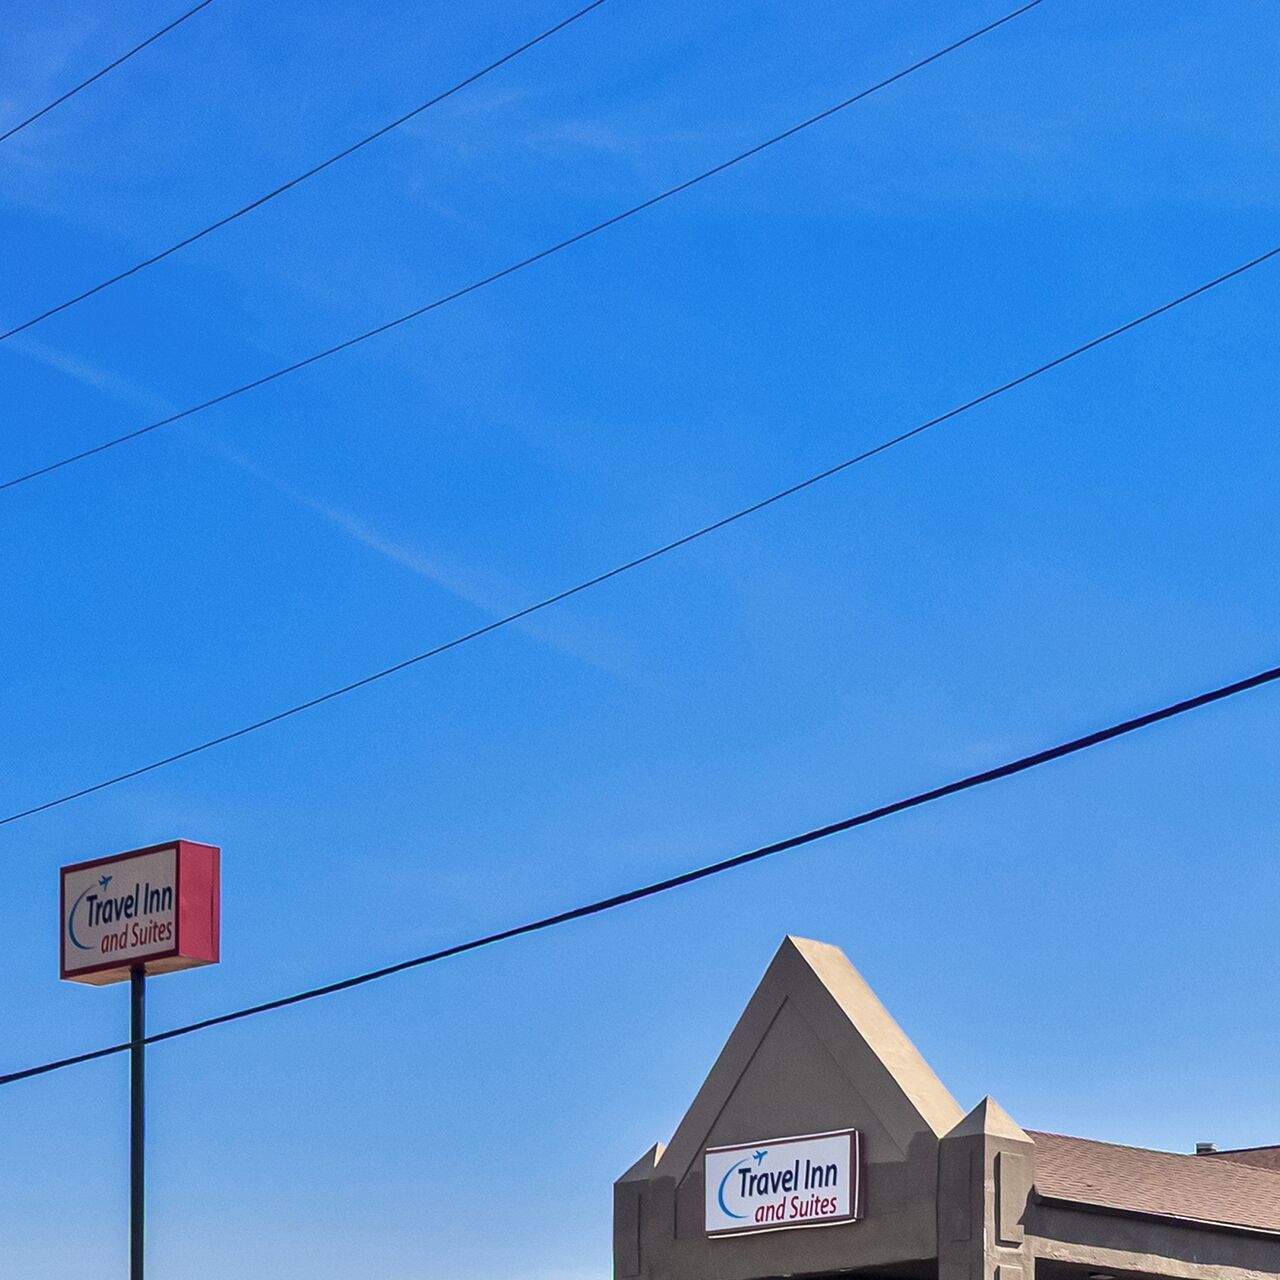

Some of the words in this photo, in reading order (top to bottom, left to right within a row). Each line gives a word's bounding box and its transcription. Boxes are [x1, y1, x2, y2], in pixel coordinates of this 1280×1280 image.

[86, 883, 138, 927] Travel
[143, 882, 173, 916] Inn
[101, 924, 128, 954] and
[130, 920, 173, 947] Suites
[738, 1160, 800, 1198] Travel
[804, 1159, 838, 1189] Inn
[755, 1196, 786, 1223] and
[789, 1194, 837, 1219] Suites
